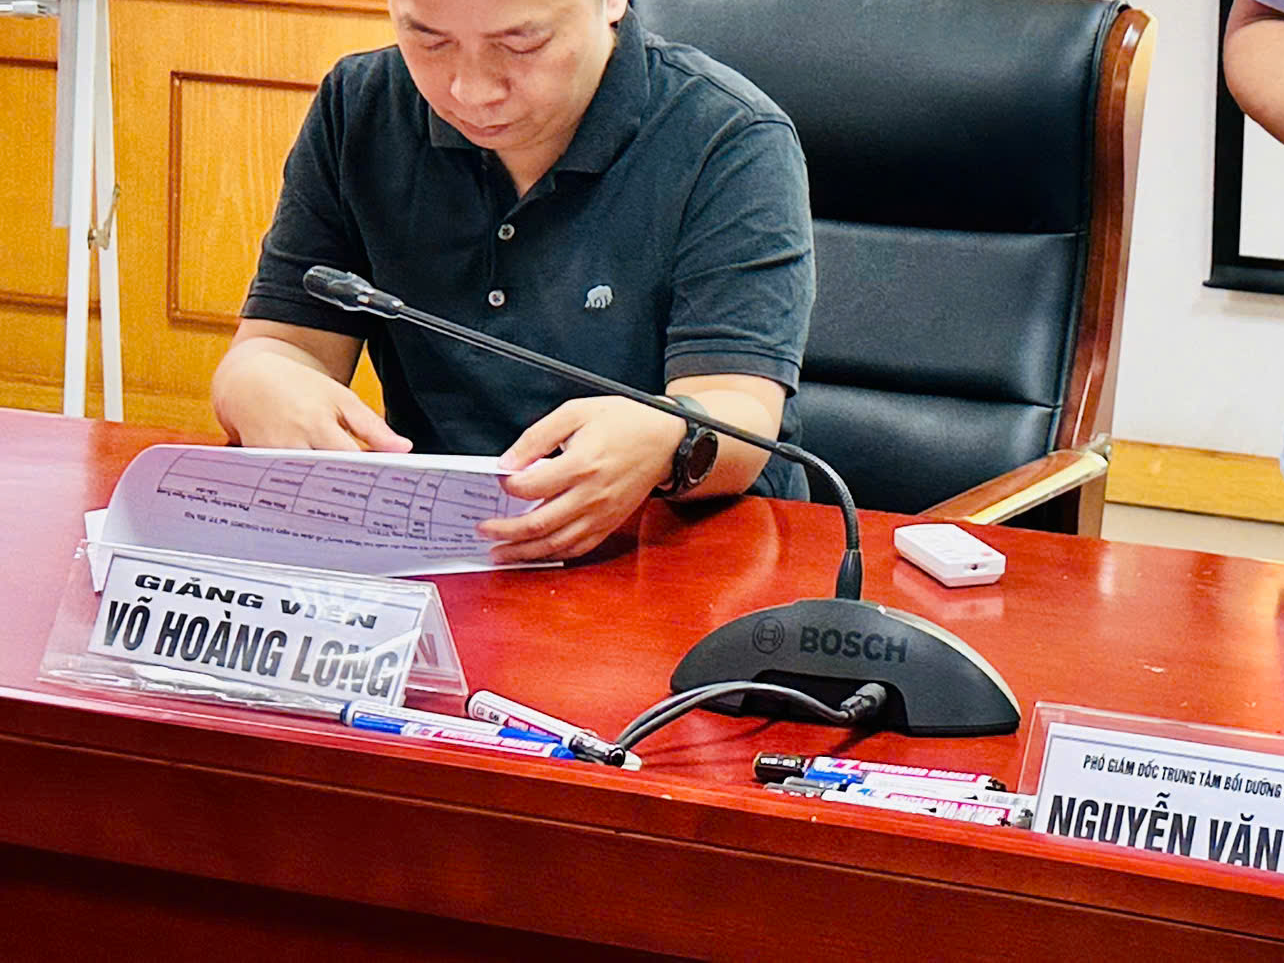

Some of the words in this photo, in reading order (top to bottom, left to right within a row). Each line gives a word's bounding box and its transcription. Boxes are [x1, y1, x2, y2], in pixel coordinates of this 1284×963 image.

[135, 574, 264, 609] GIẢNG
[103, 596, 153, 651] VÕ
[153, 610, 288, 677] HOÀNG
[290, 635, 401, 698] LONG
[800, 625, 909, 664] BOSCH
[1161, 766, 1196, 785] TRUNG
[1048, 792, 1197, 857] NGUYỄN
[1208, 813, 1284, 873] VĂN
